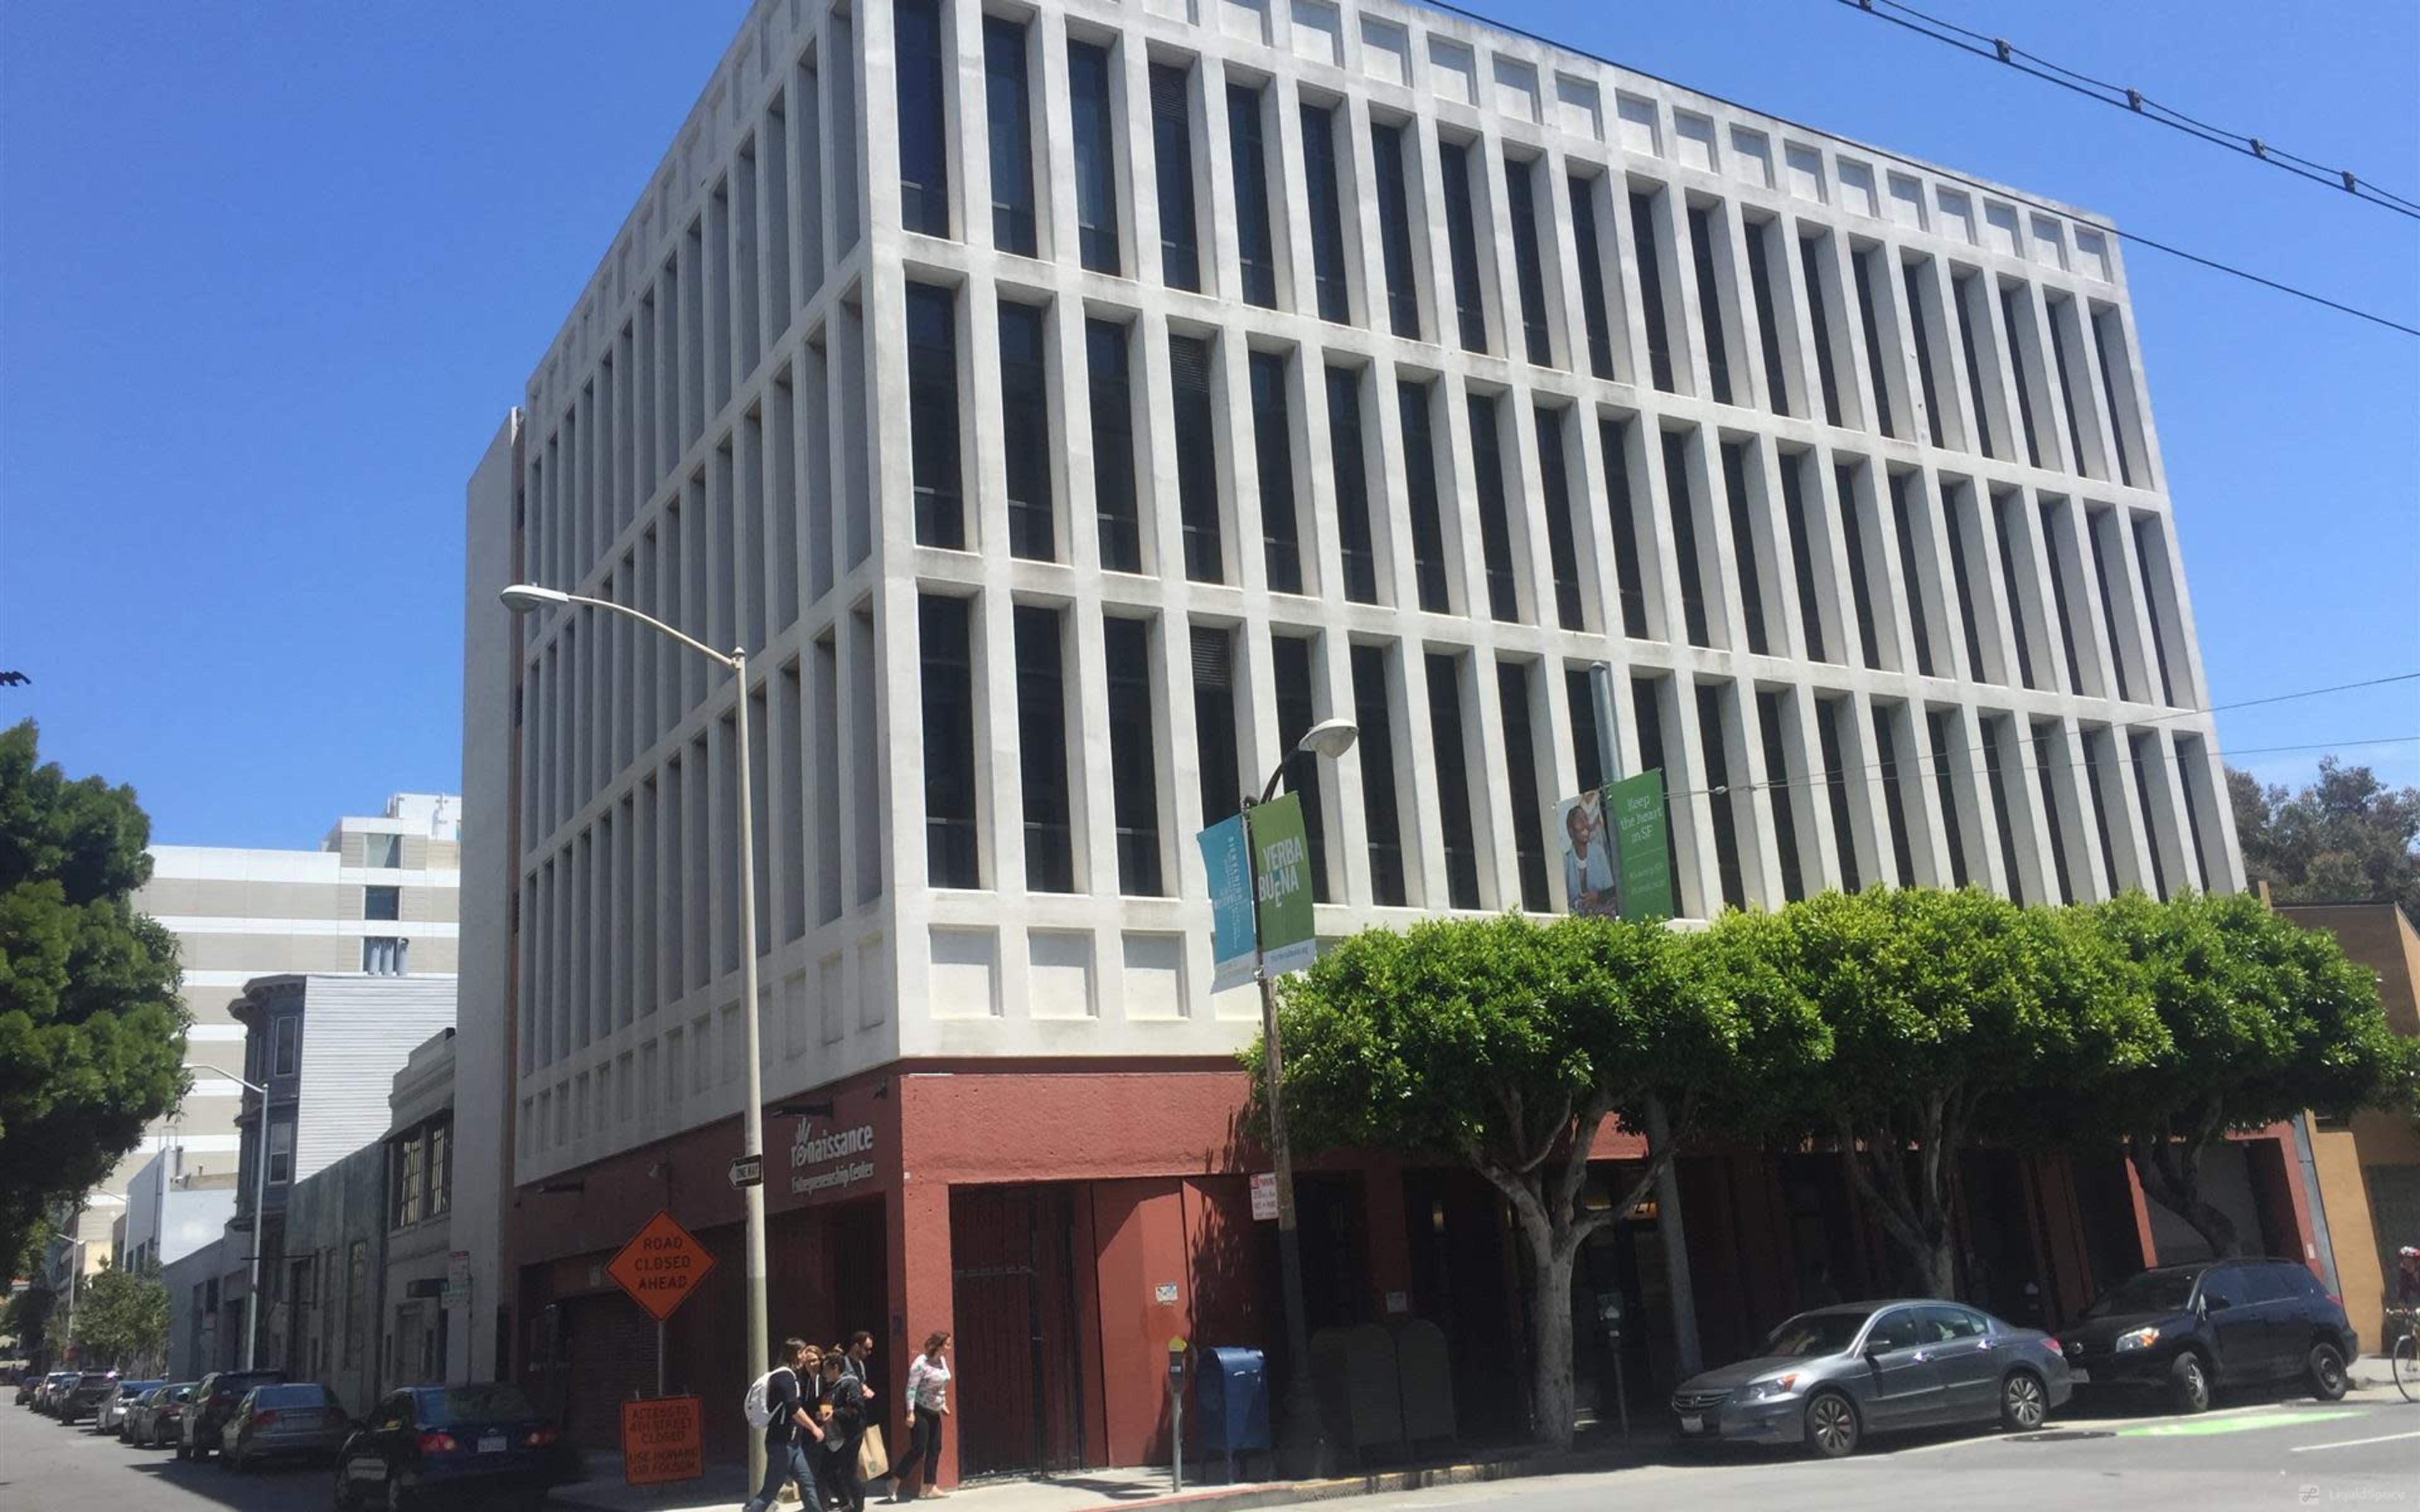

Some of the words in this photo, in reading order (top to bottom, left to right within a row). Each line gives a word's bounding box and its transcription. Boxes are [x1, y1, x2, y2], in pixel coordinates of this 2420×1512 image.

[1627, 795, 1651, 811] Keep
[1263, 836, 1304, 871] YERBA
[1259, 866, 1299, 908] BUENA
[850, 1160, 874, 1181] Center
[643, 1236, 683, 1250] ROAD
[635, 1256, 691, 1271] CLOSED
[638, 1275, 687, 1290] AHEAD
[632, 1407, 674, 1419] ACCESS
[676, 1406, 690, 1416] TO
[654, 1418, 692, 1431] STREET
[642, 1431, 686, 1443] CLOSED
[628, 1450, 650, 1462] USE
